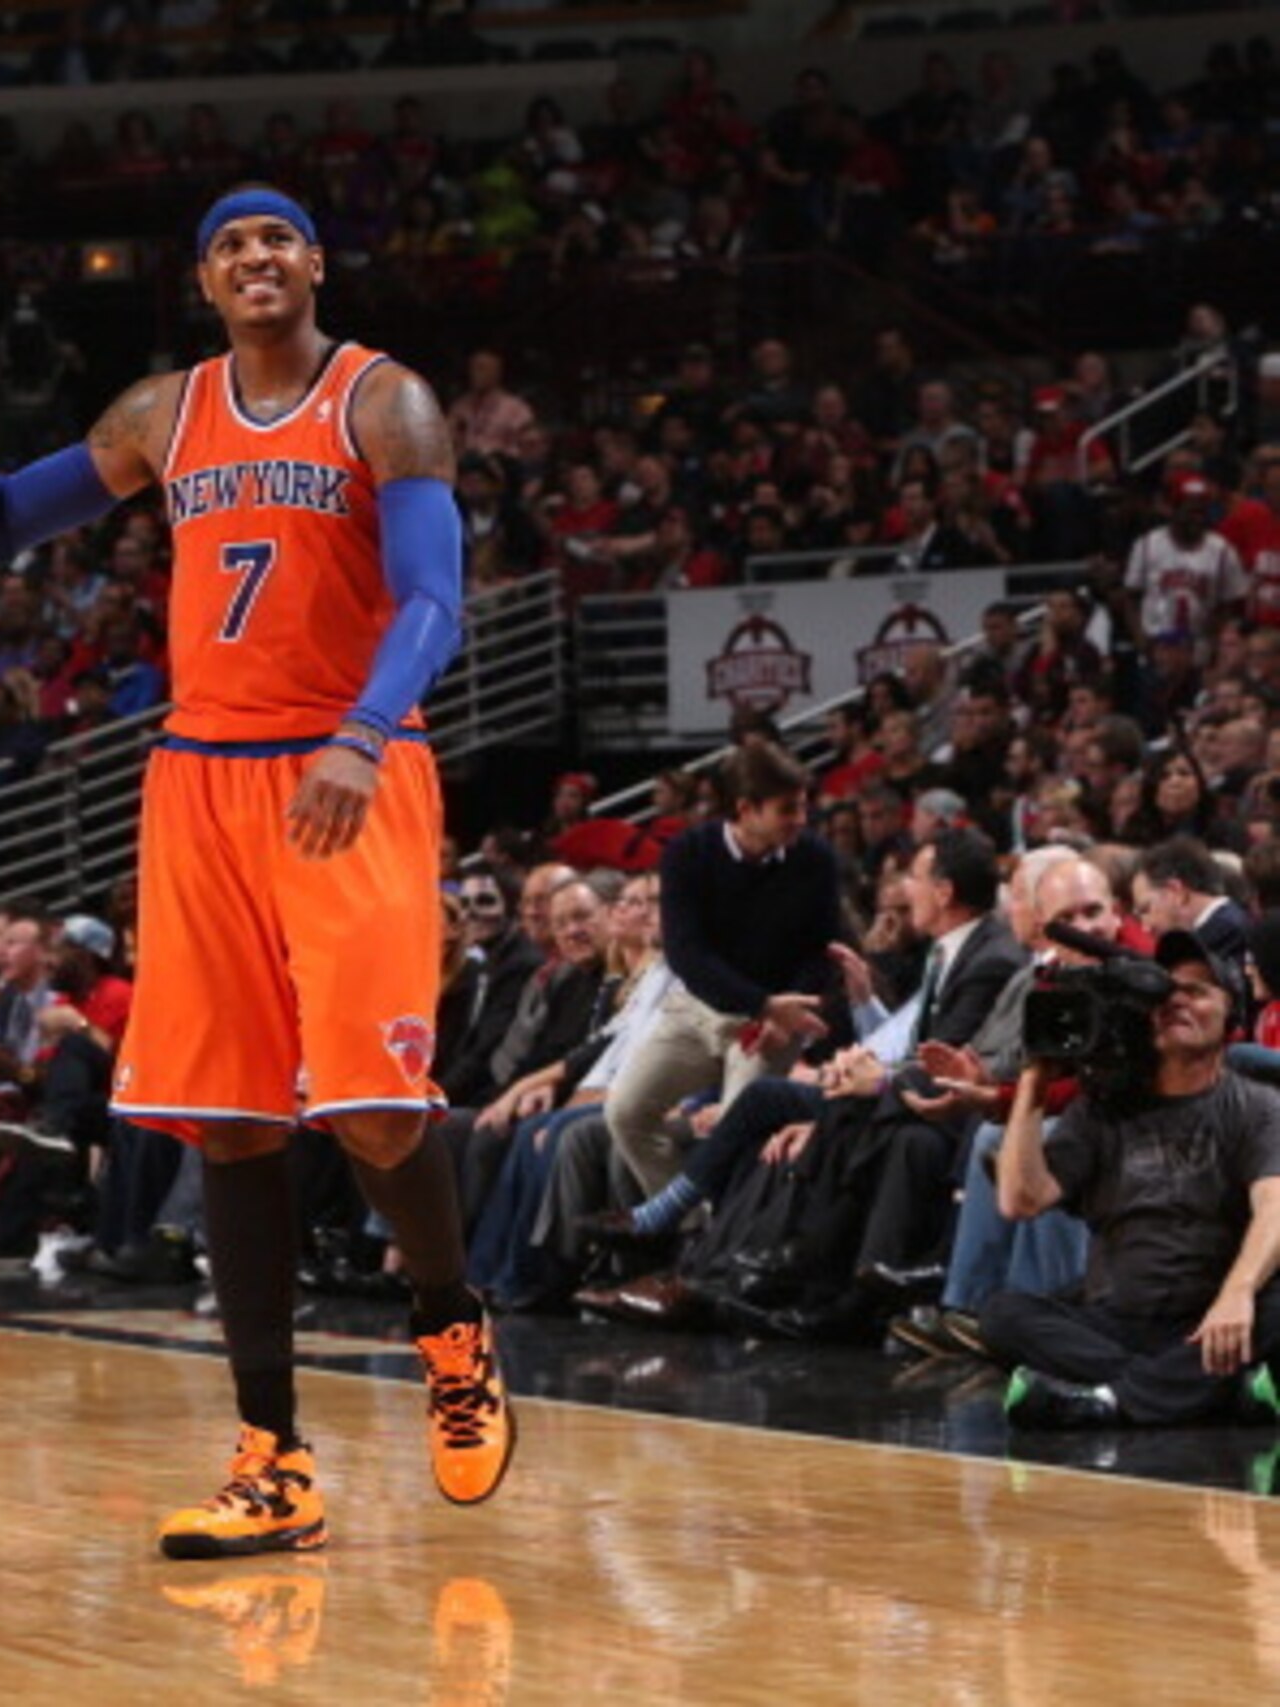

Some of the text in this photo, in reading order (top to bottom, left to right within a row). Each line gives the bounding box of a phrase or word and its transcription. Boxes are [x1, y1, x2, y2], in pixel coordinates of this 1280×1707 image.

[167, 460, 351, 526] NEW YORK
[218, 538, 277, 642] 7
